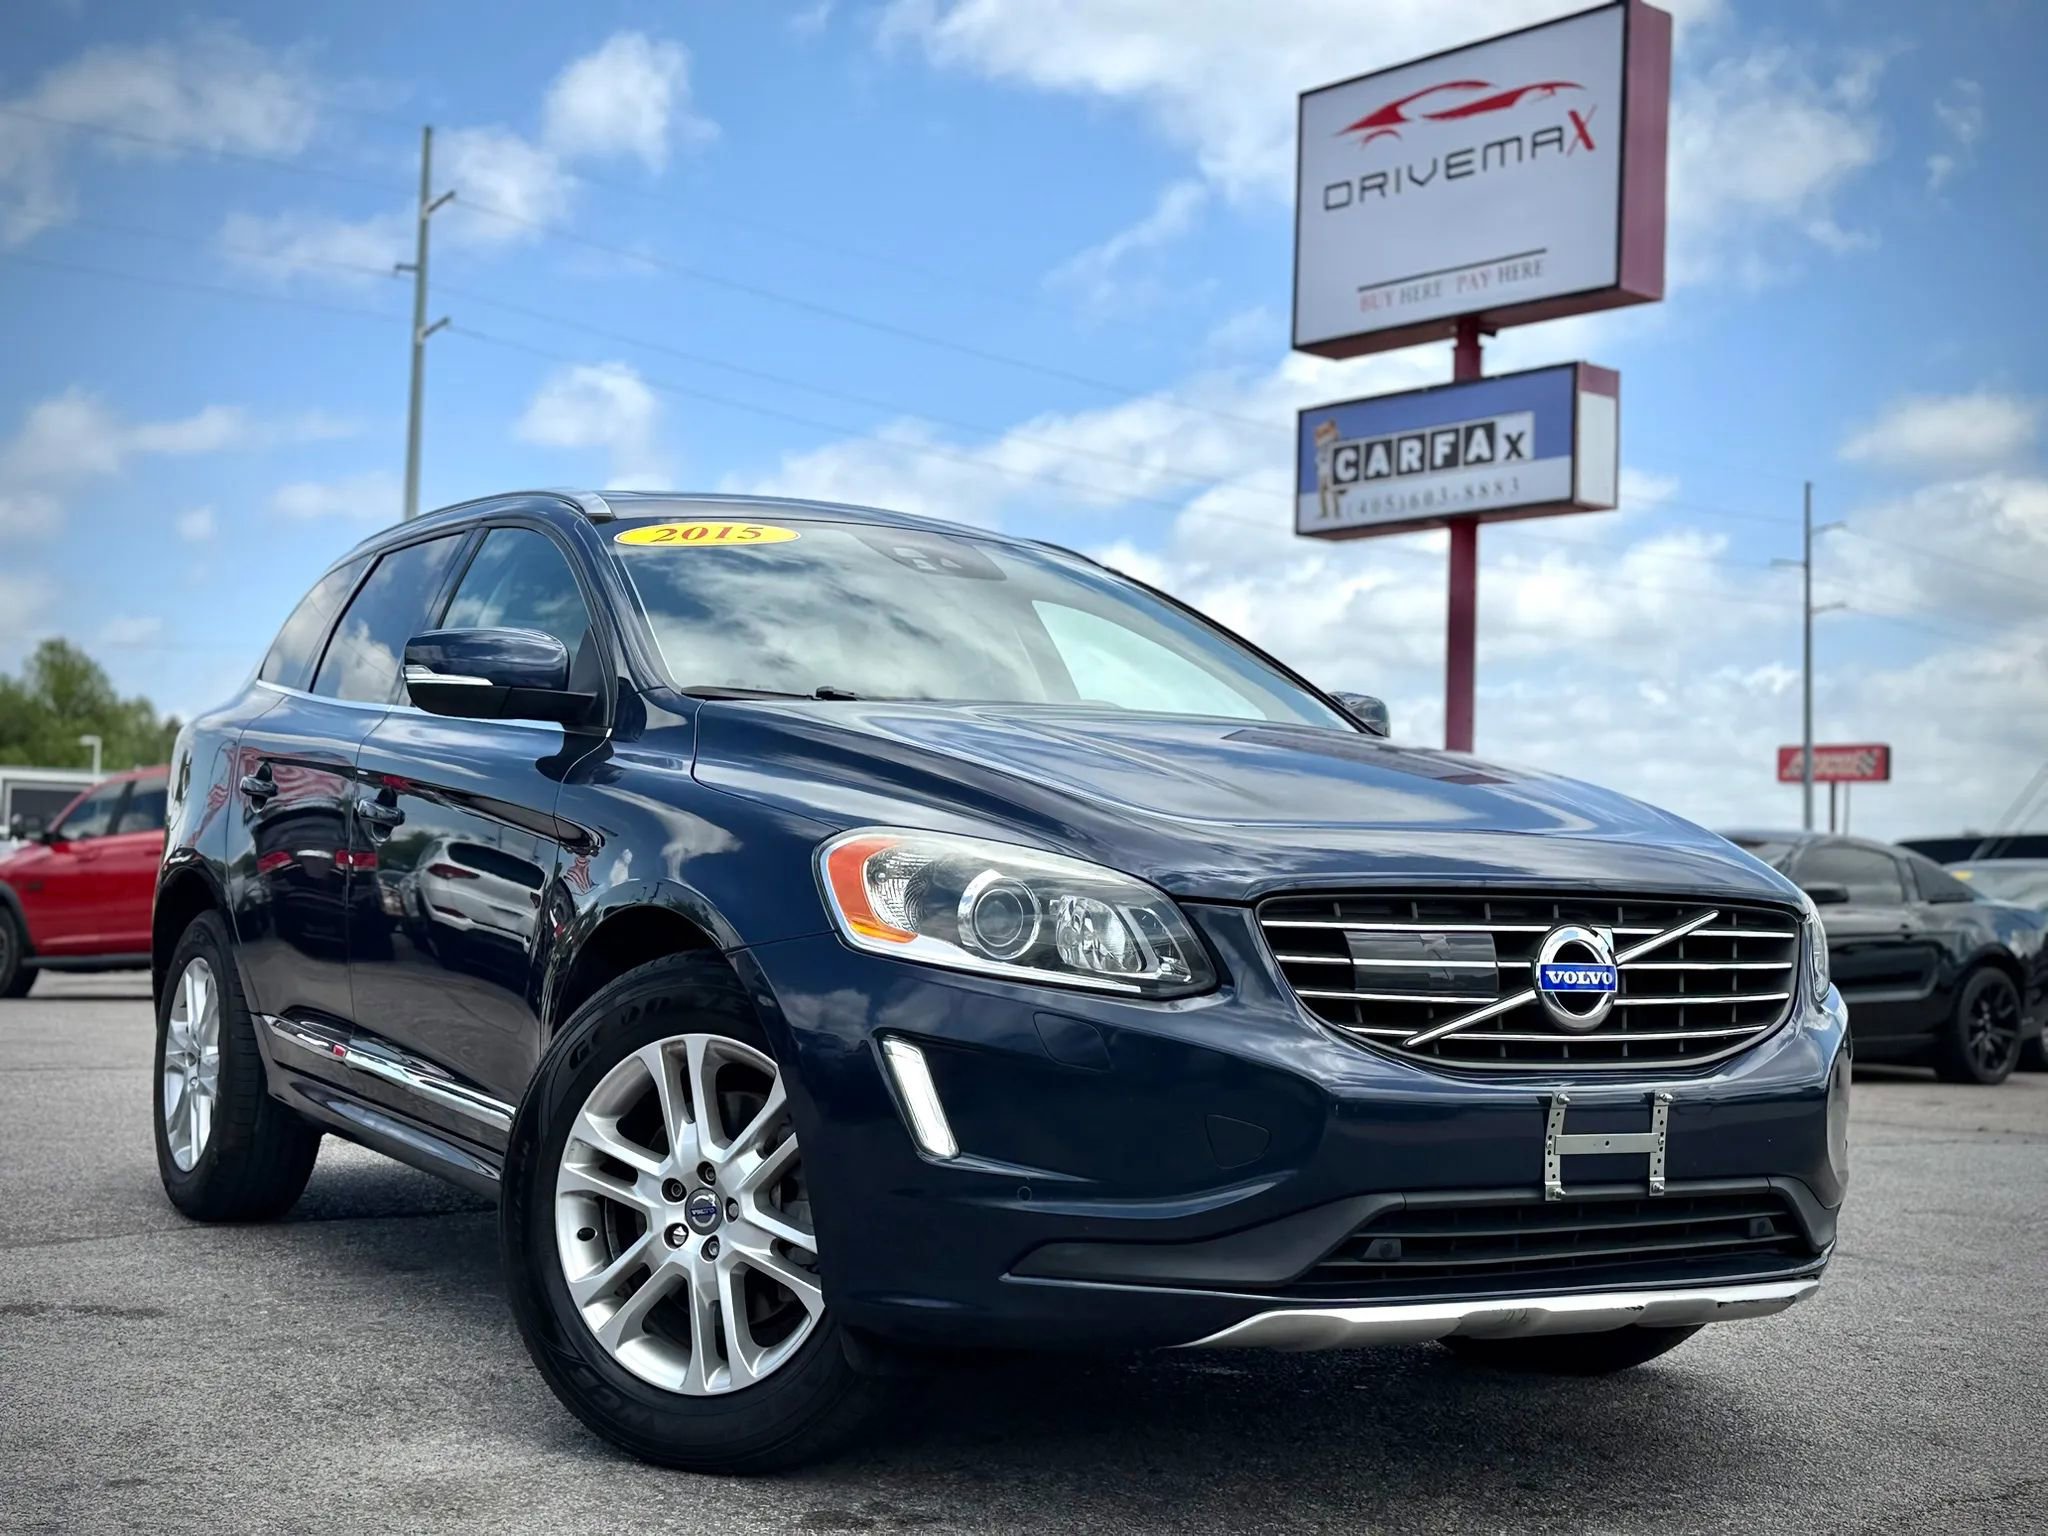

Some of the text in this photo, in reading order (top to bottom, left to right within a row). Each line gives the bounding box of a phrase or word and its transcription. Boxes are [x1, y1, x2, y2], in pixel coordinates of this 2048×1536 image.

[1323, 104, 1597, 211] DRIVEMAX
[1360, 259, 1544, 313] BUY HERE PAY HERE
[1334, 422, 1528, 483] CARFAX
[650, 526, 763, 543] 2015
[1545, 969, 1613, 986] VOLVO
